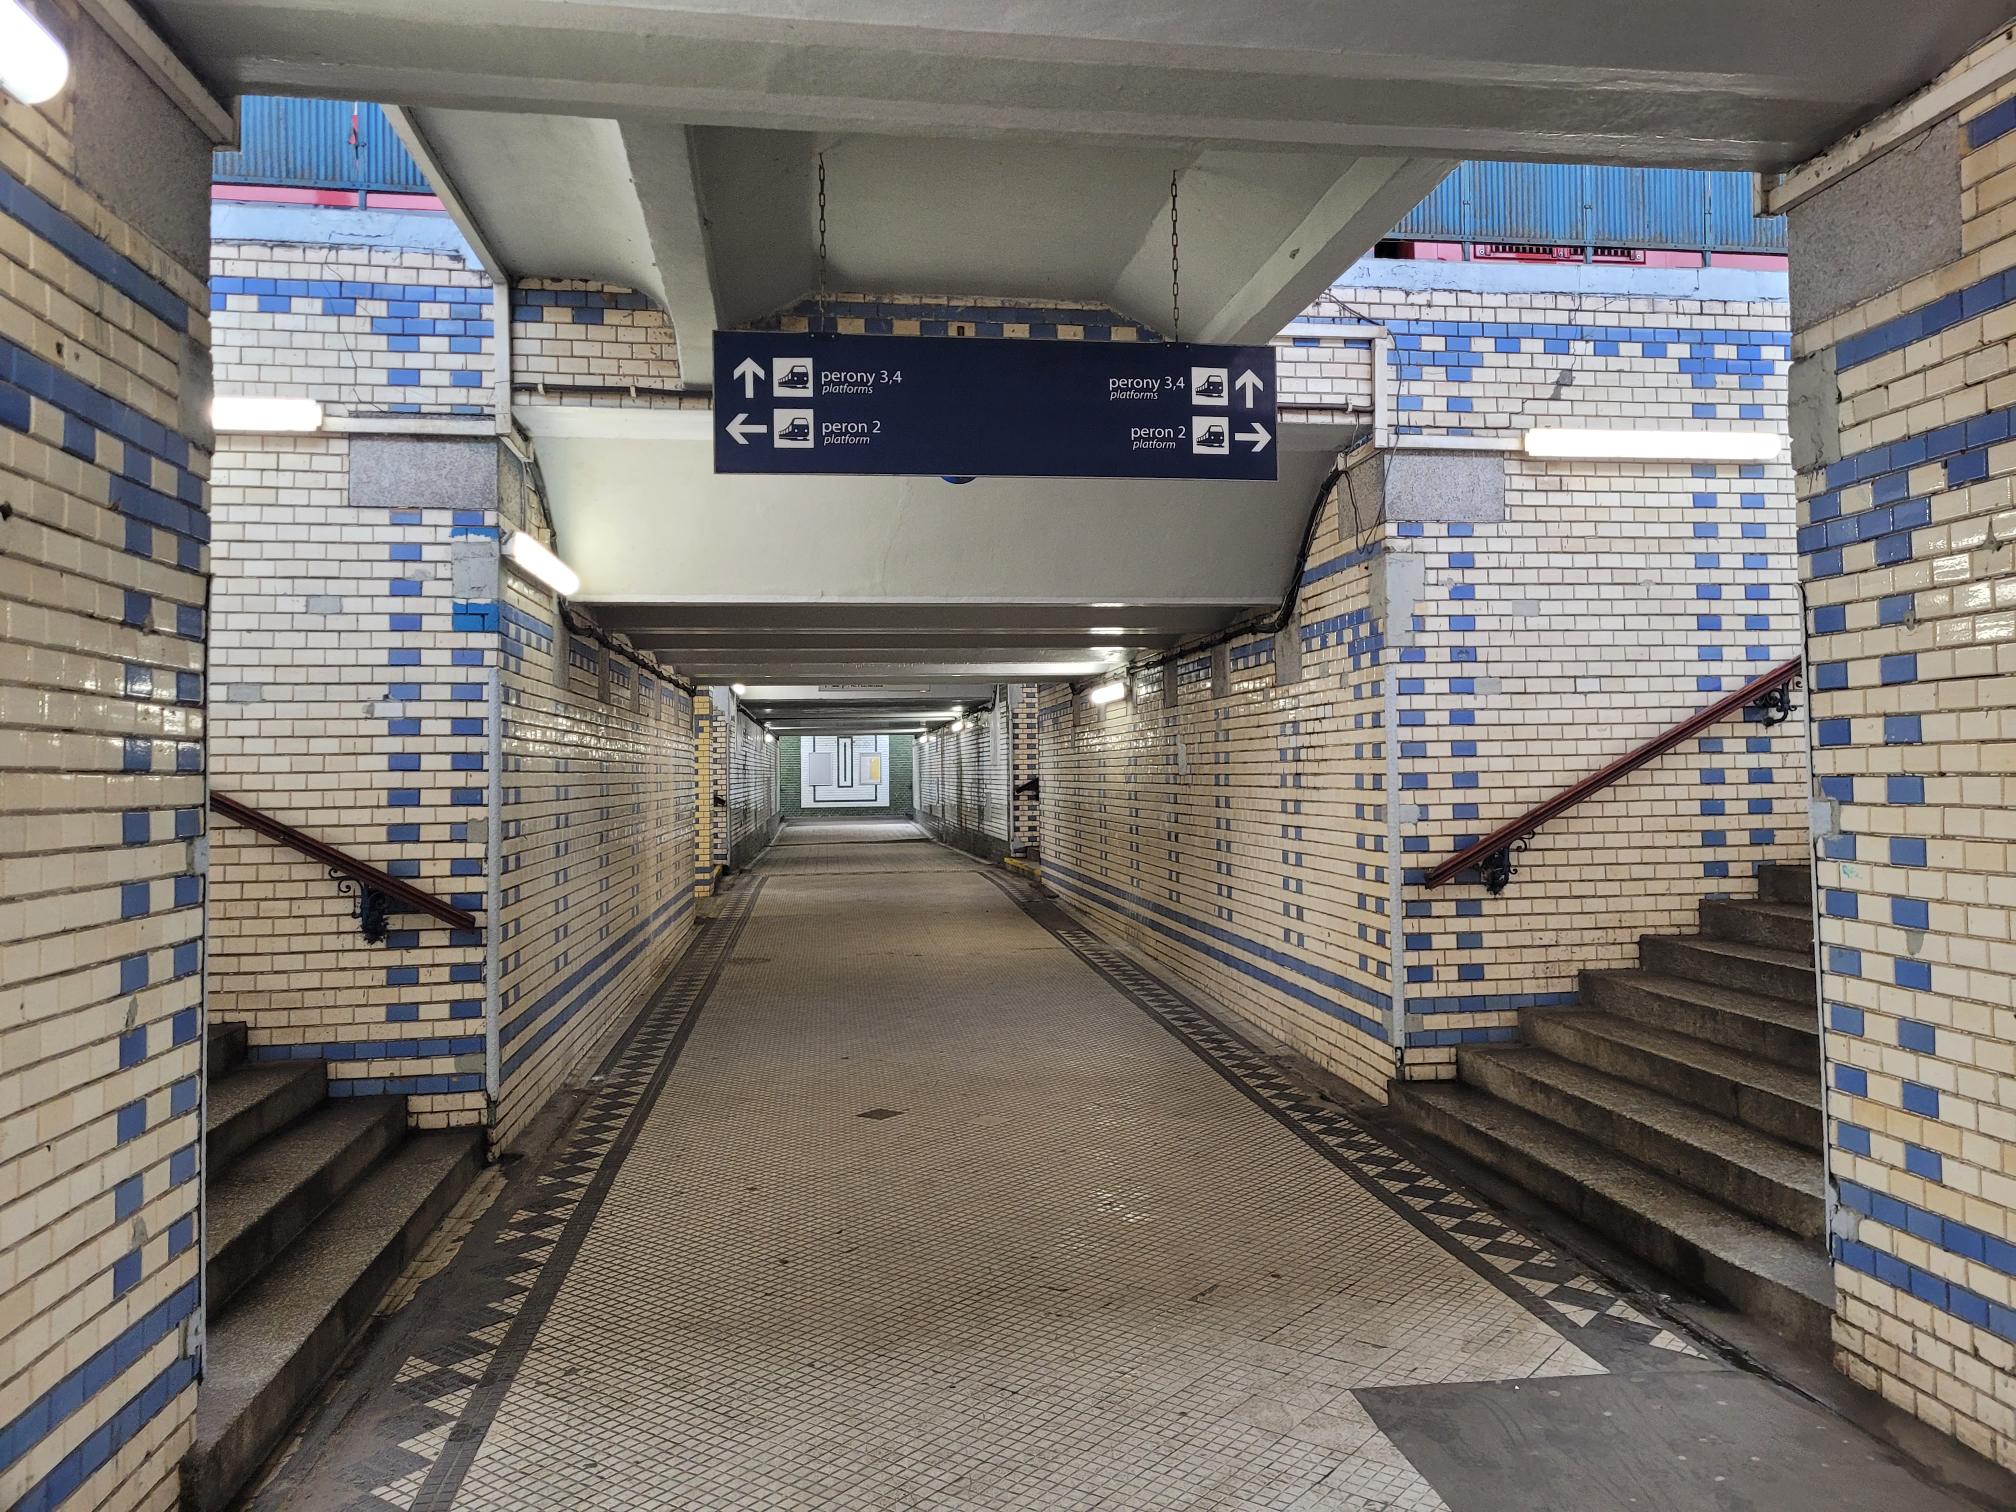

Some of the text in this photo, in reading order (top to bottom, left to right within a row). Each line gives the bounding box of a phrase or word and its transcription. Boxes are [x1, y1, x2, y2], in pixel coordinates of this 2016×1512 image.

[821, 370, 903, 386] perony 3,4
[1109, 376, 1186, 392] perony 3,4
[822, 383, 873, 396] platforms
[1110, 389, 1158, 401] platforms
[822, 420, 881, 436] peron 2
[1131, 425, 1187, 441] peron 2
[823, 433, 870, 447] platform
[1132, 439, 1176, 451] platform
